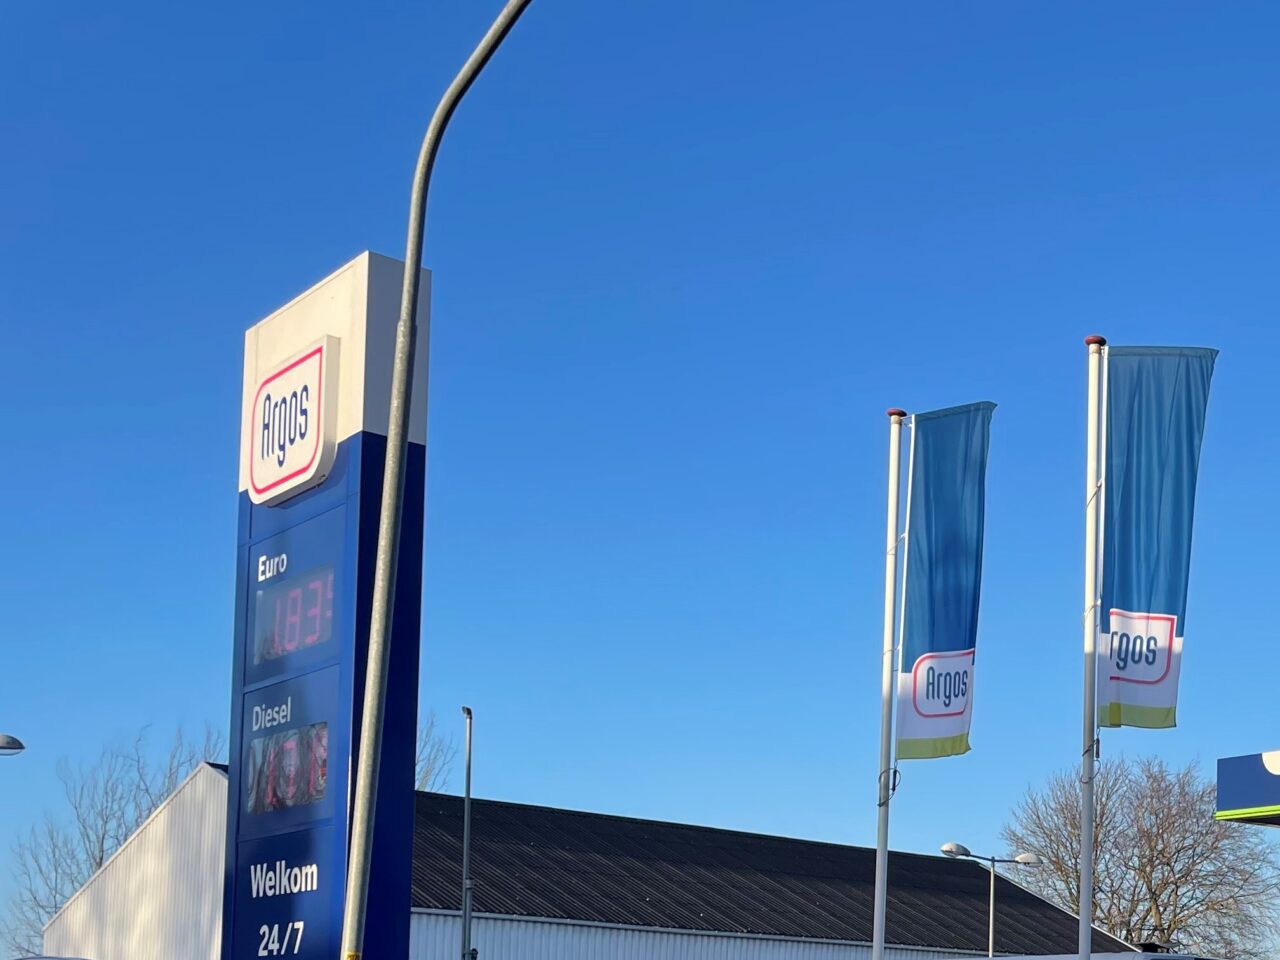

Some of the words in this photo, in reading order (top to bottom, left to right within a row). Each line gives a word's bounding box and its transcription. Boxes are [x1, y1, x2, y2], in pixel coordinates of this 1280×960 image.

[262, 385, 309, 467] Argos
[258, 554, 287, 582] Euro
[1110, 631, 1158, 670] rgos
[926, 666, 968, 707] Argos
[252, 696, 291, 731] Diesel
[250, 860, 318, 898] Welkom
[258, 921, 304, 956] 24/7
